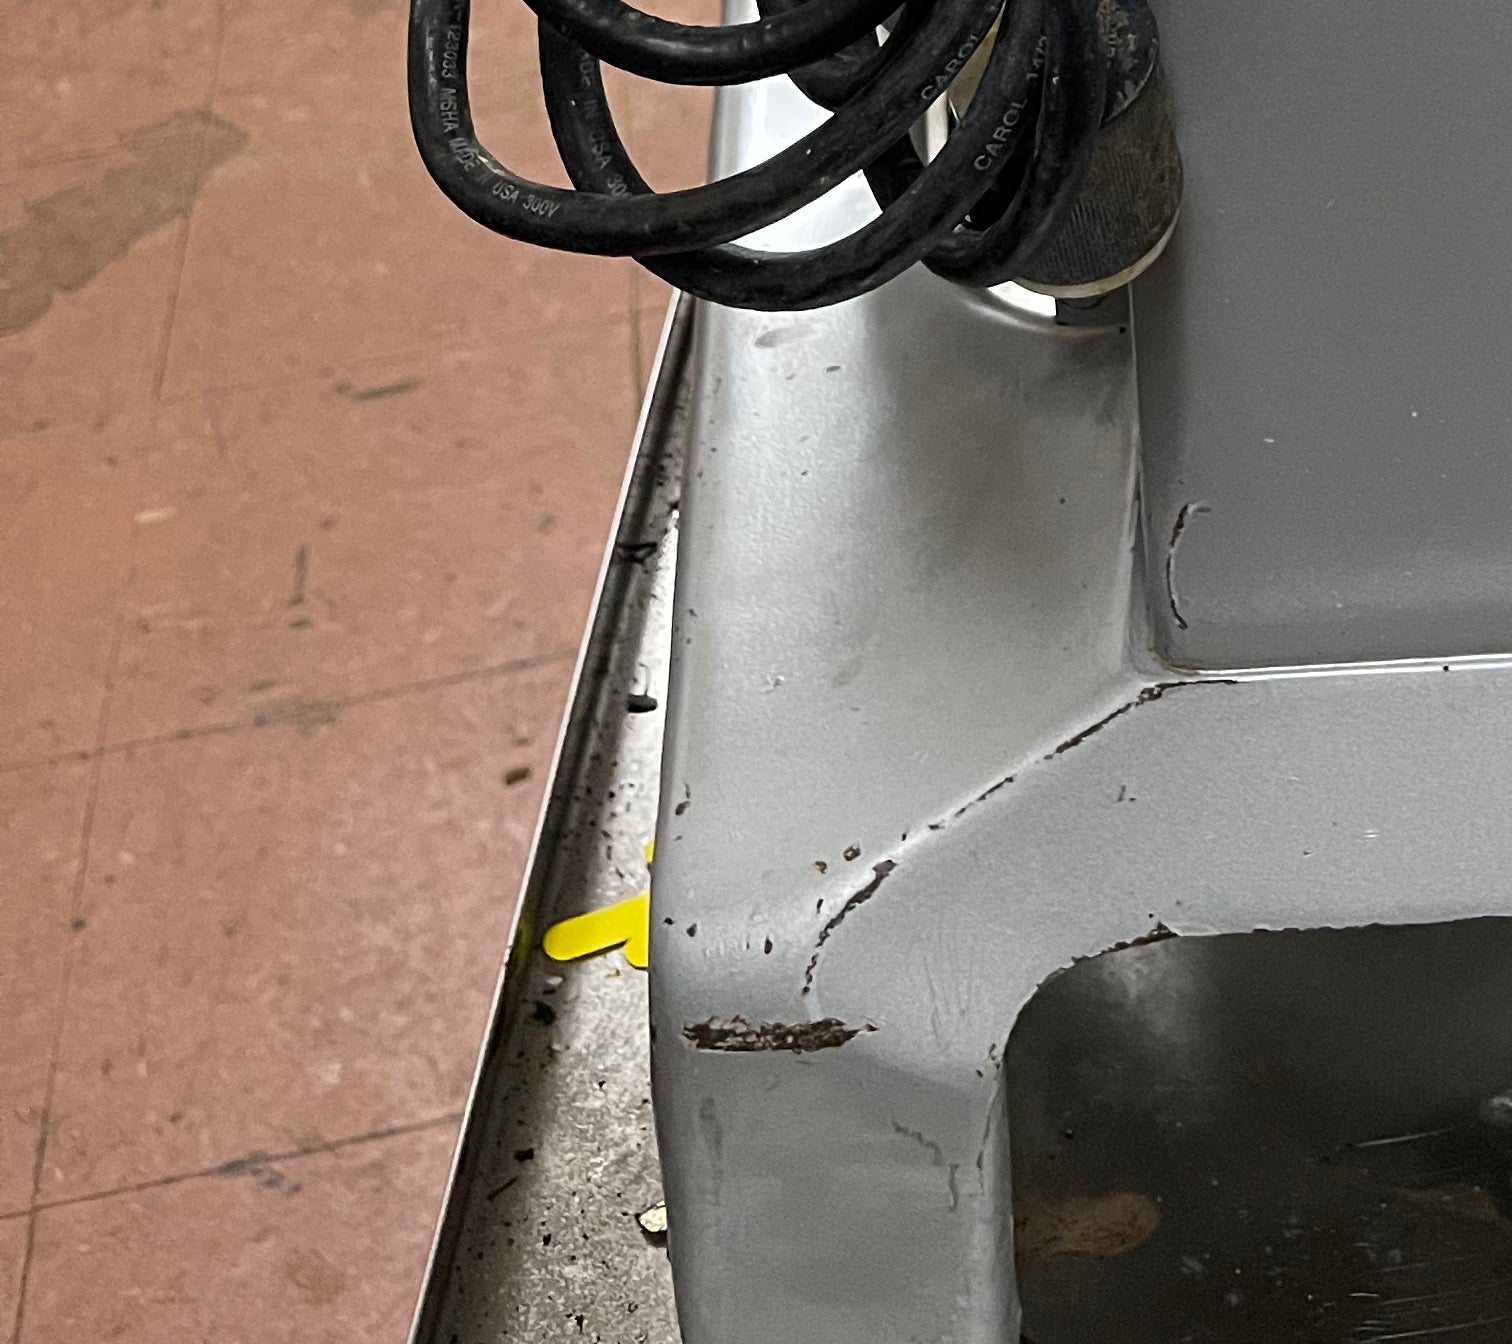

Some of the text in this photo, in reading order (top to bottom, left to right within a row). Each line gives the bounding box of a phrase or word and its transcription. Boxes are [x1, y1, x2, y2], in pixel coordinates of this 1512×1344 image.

[439, 88, 460, 133] MSHA
[973, 97, 1029, 172] CAROL
[491, 181, 562, 218] USA 300V
